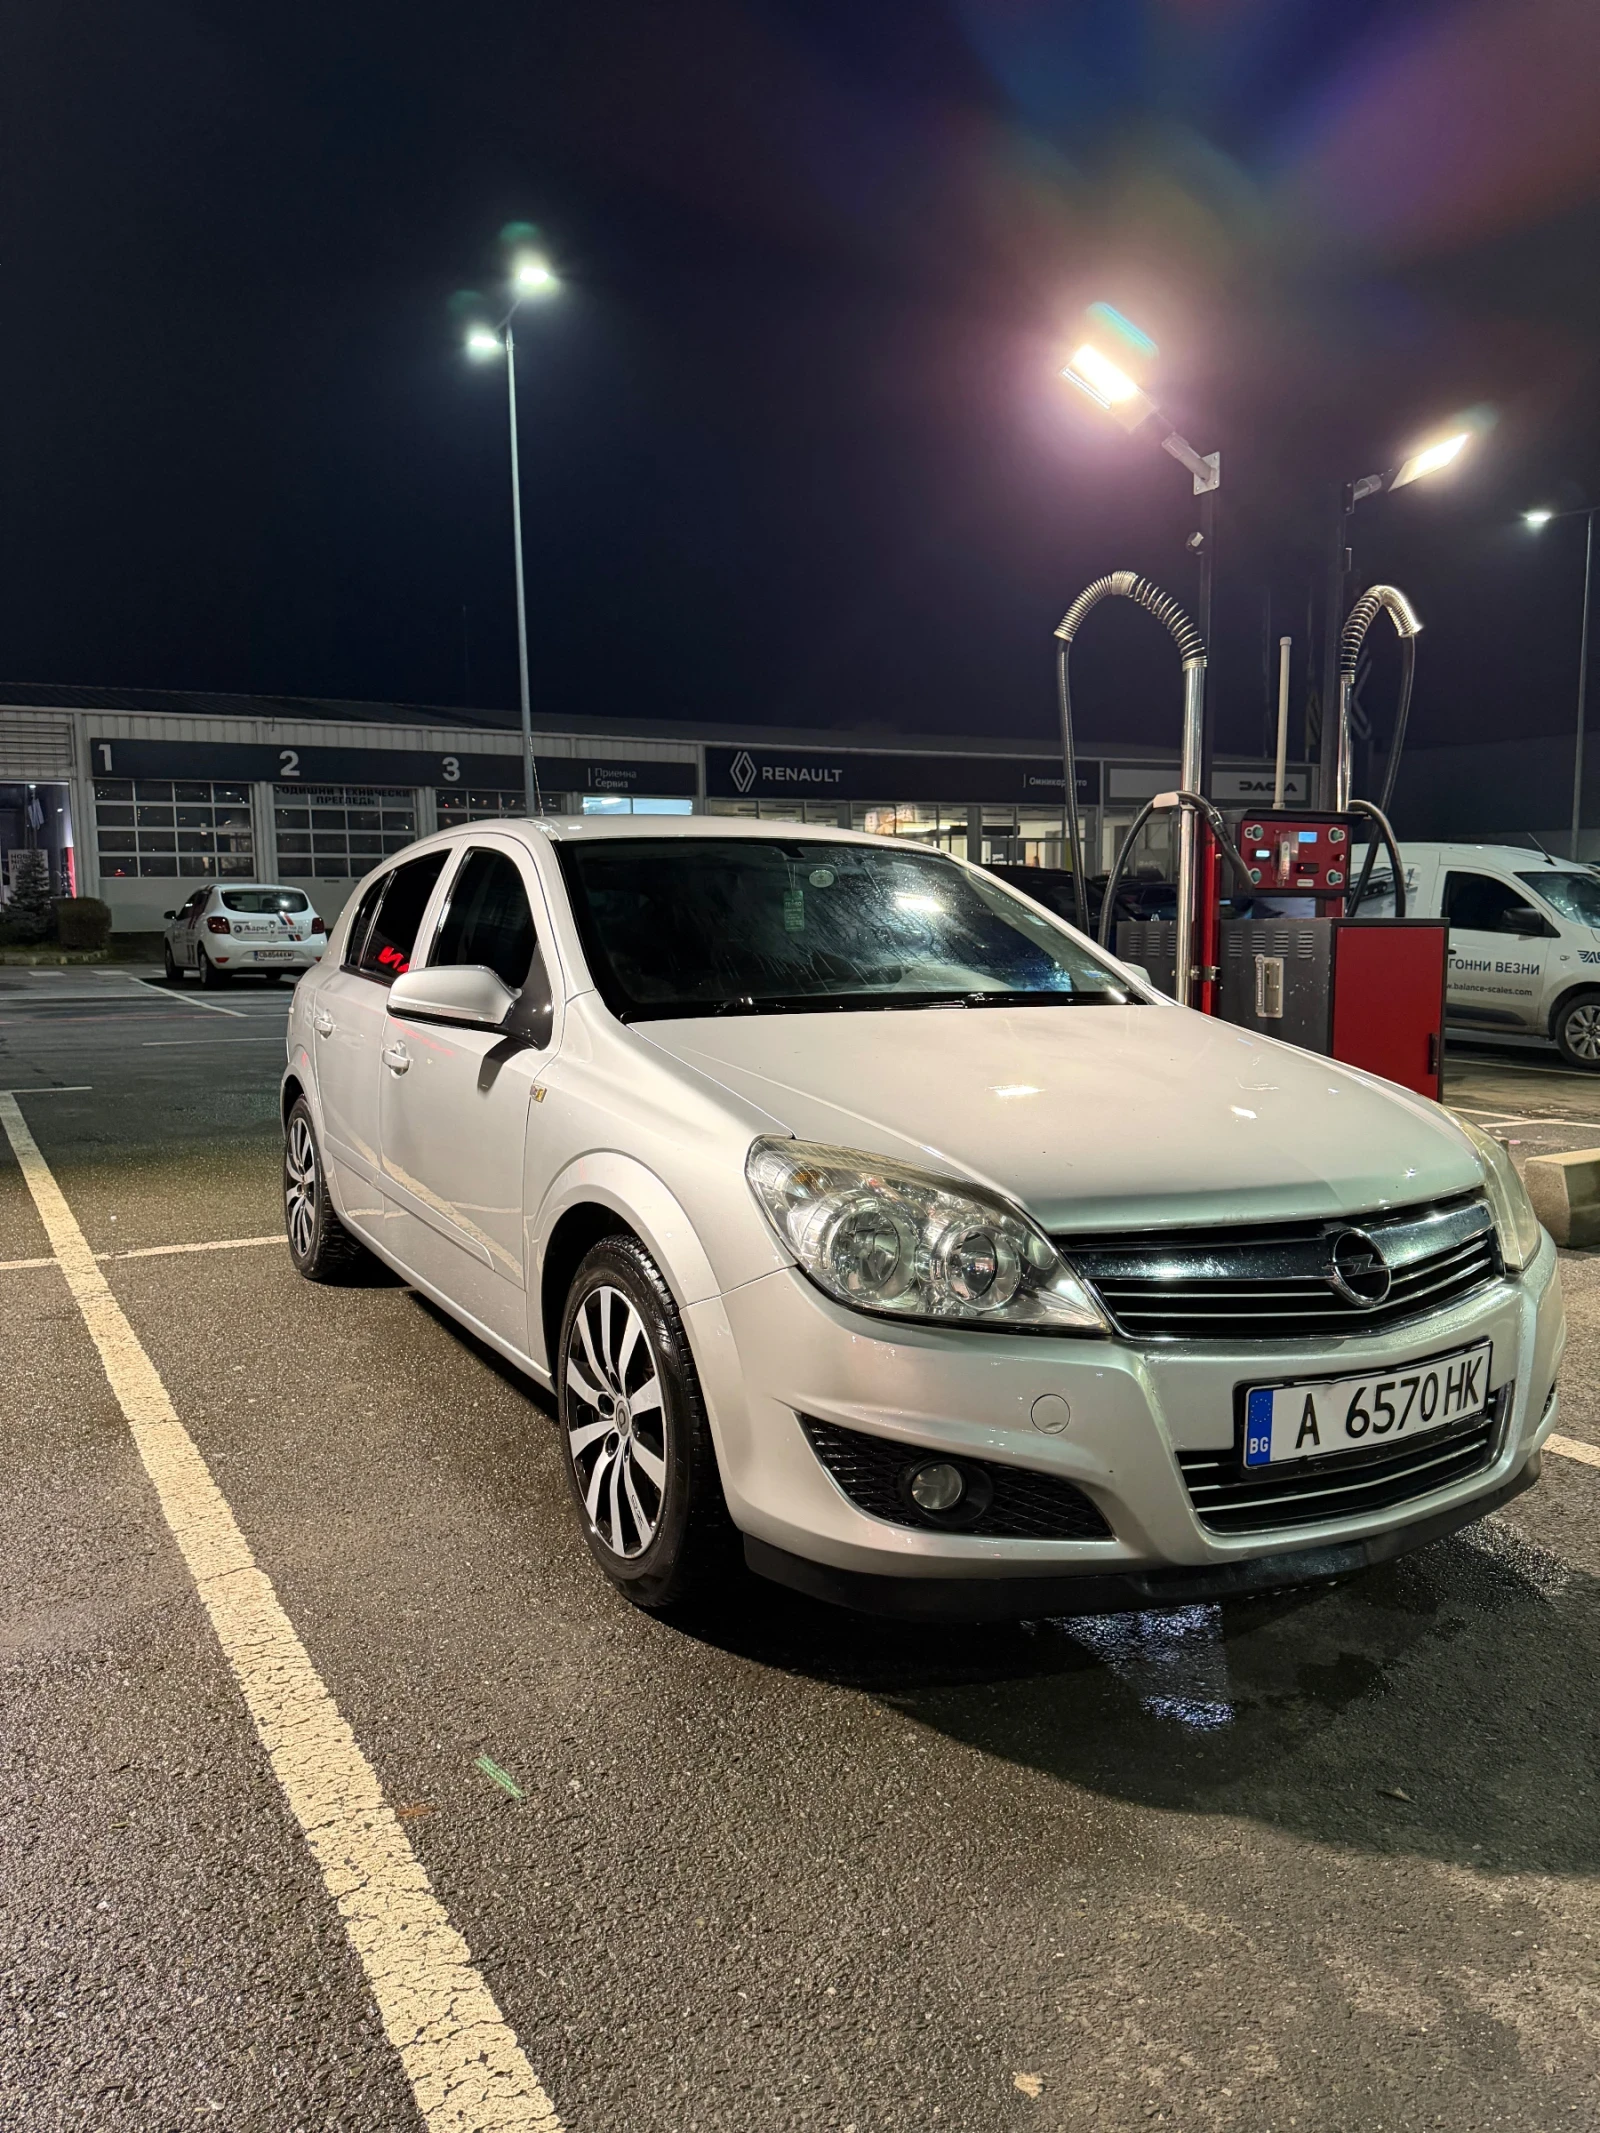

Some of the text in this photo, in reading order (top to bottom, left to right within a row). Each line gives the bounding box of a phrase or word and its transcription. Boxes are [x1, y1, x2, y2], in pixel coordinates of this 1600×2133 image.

[99, 743, 113, 772] 1
[279, 750, 300, 776] 2
[442, 756, 461, 782] 3
[594, 767, 637, 779] Приемна
[762, 766, 843, 783] RENAULT
[594, 778, 629, 789] Сервиз
[1239, 781, 1298, 792] DACA
[1449, 958, 1540, 975] ГОННИ ВЕЗНИ
[1446, 982, 1533, 996] w.balance-scales.com
[1295, 1392, 1321, 1449] A
[1250, 1436, 1269, 1454] BG
